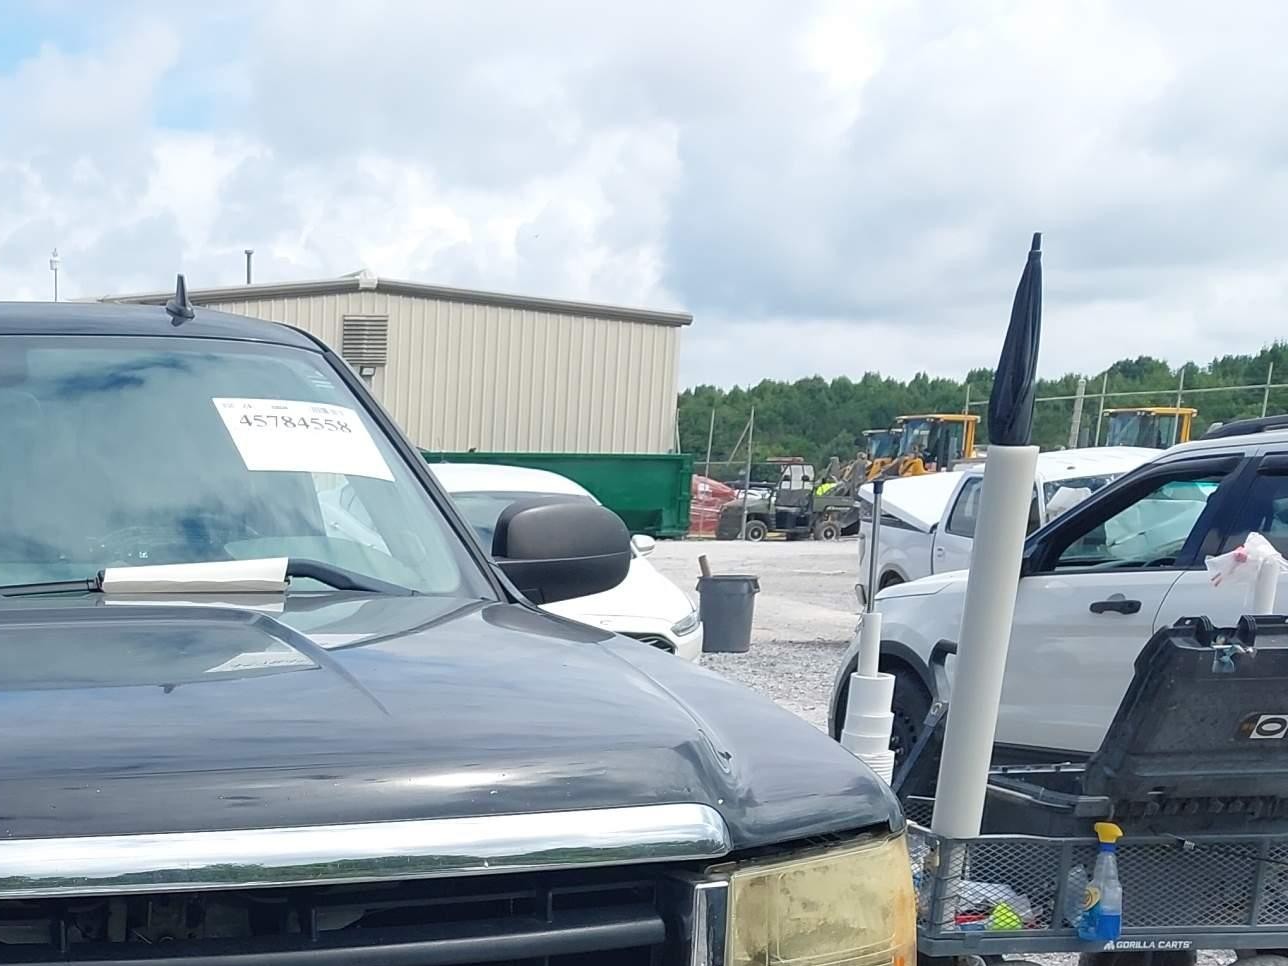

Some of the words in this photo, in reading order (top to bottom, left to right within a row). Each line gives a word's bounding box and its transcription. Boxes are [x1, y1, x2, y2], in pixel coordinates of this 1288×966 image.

[239, 413, 352, 433] 45784558
[1116, 941, 1155, 949] GORILLA
[1158, 941, 1190, 949] CARTS
